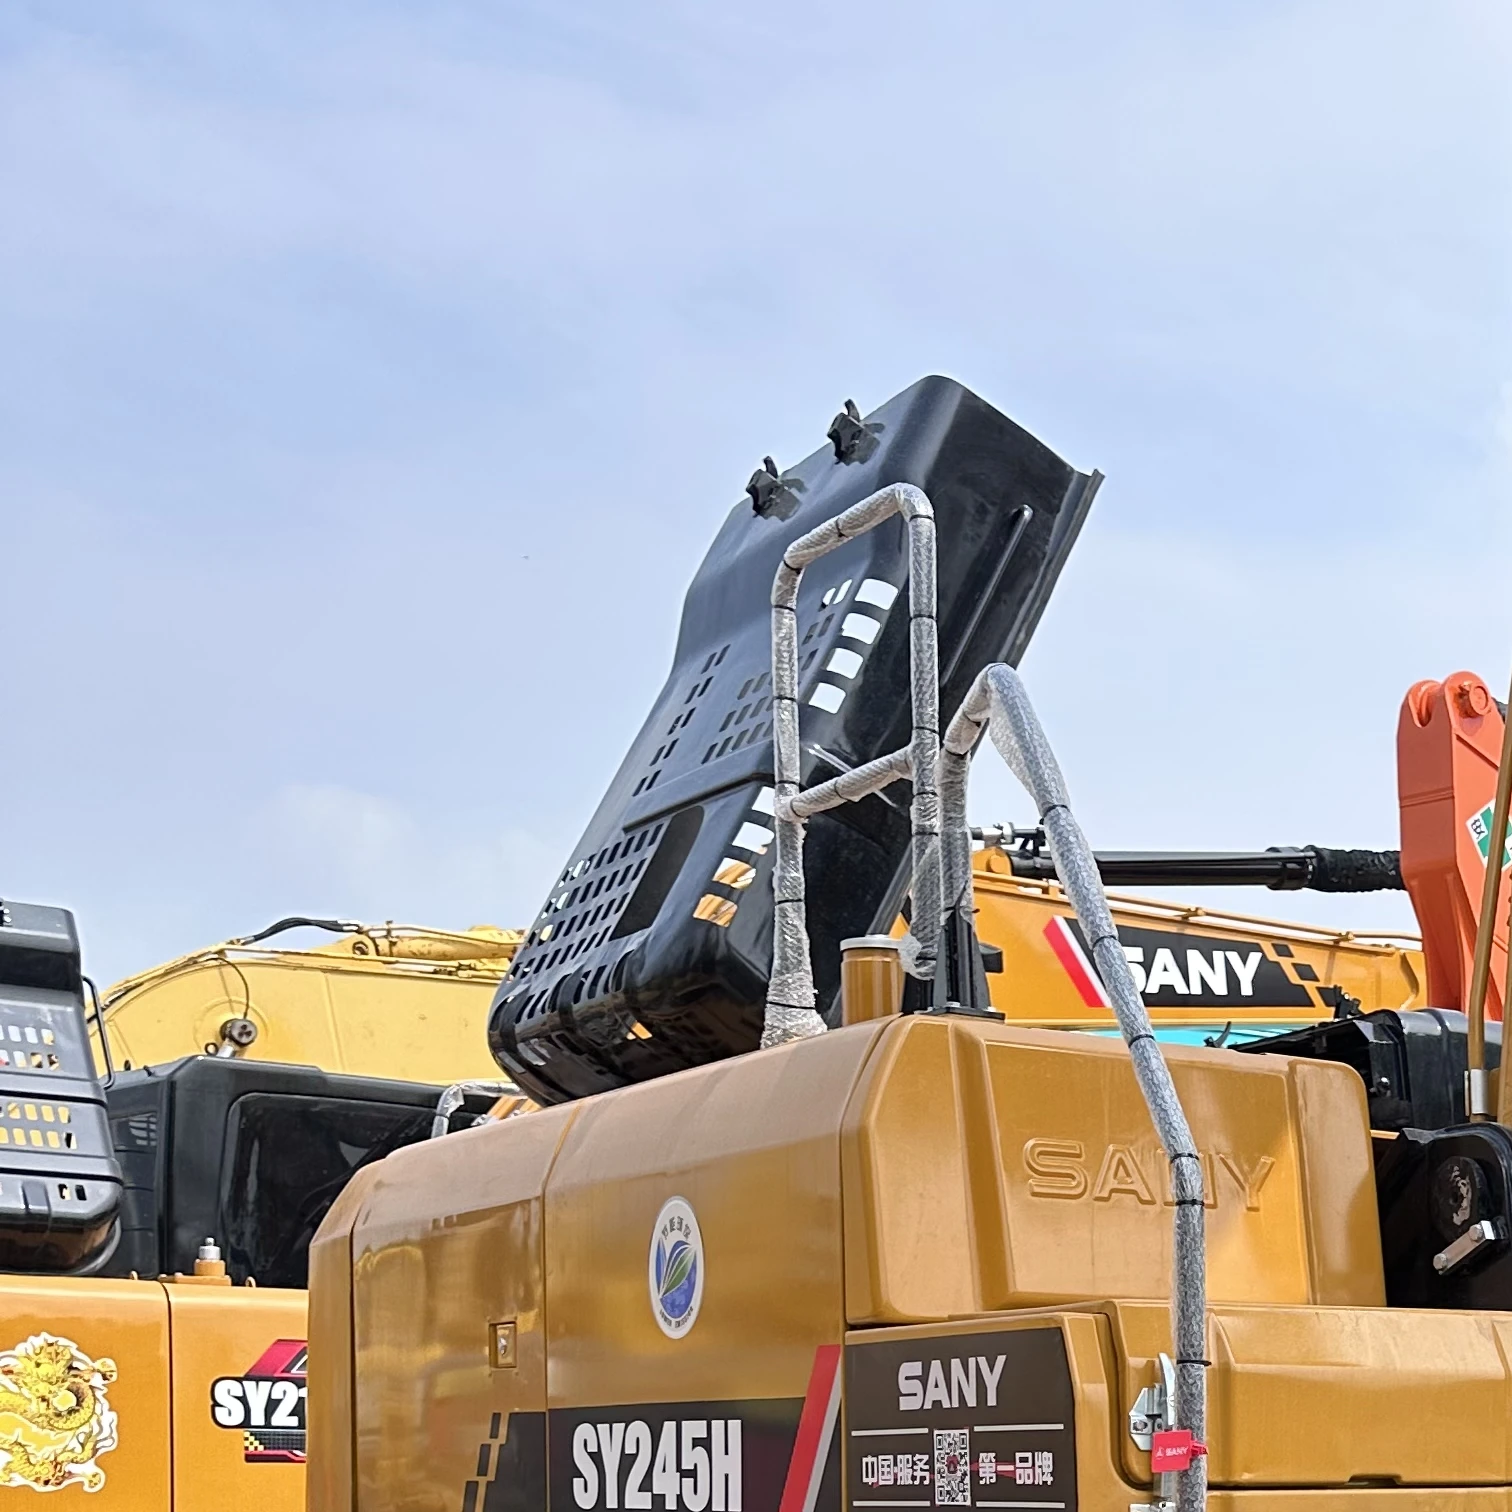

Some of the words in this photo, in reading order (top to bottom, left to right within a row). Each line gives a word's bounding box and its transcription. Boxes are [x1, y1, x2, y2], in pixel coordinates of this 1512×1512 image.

[898, 1355, 1007, 1411] SANY
[572, 1420, 742, 1512] SY245H
[978, 1451, 1054, 1486] 第一品牌
